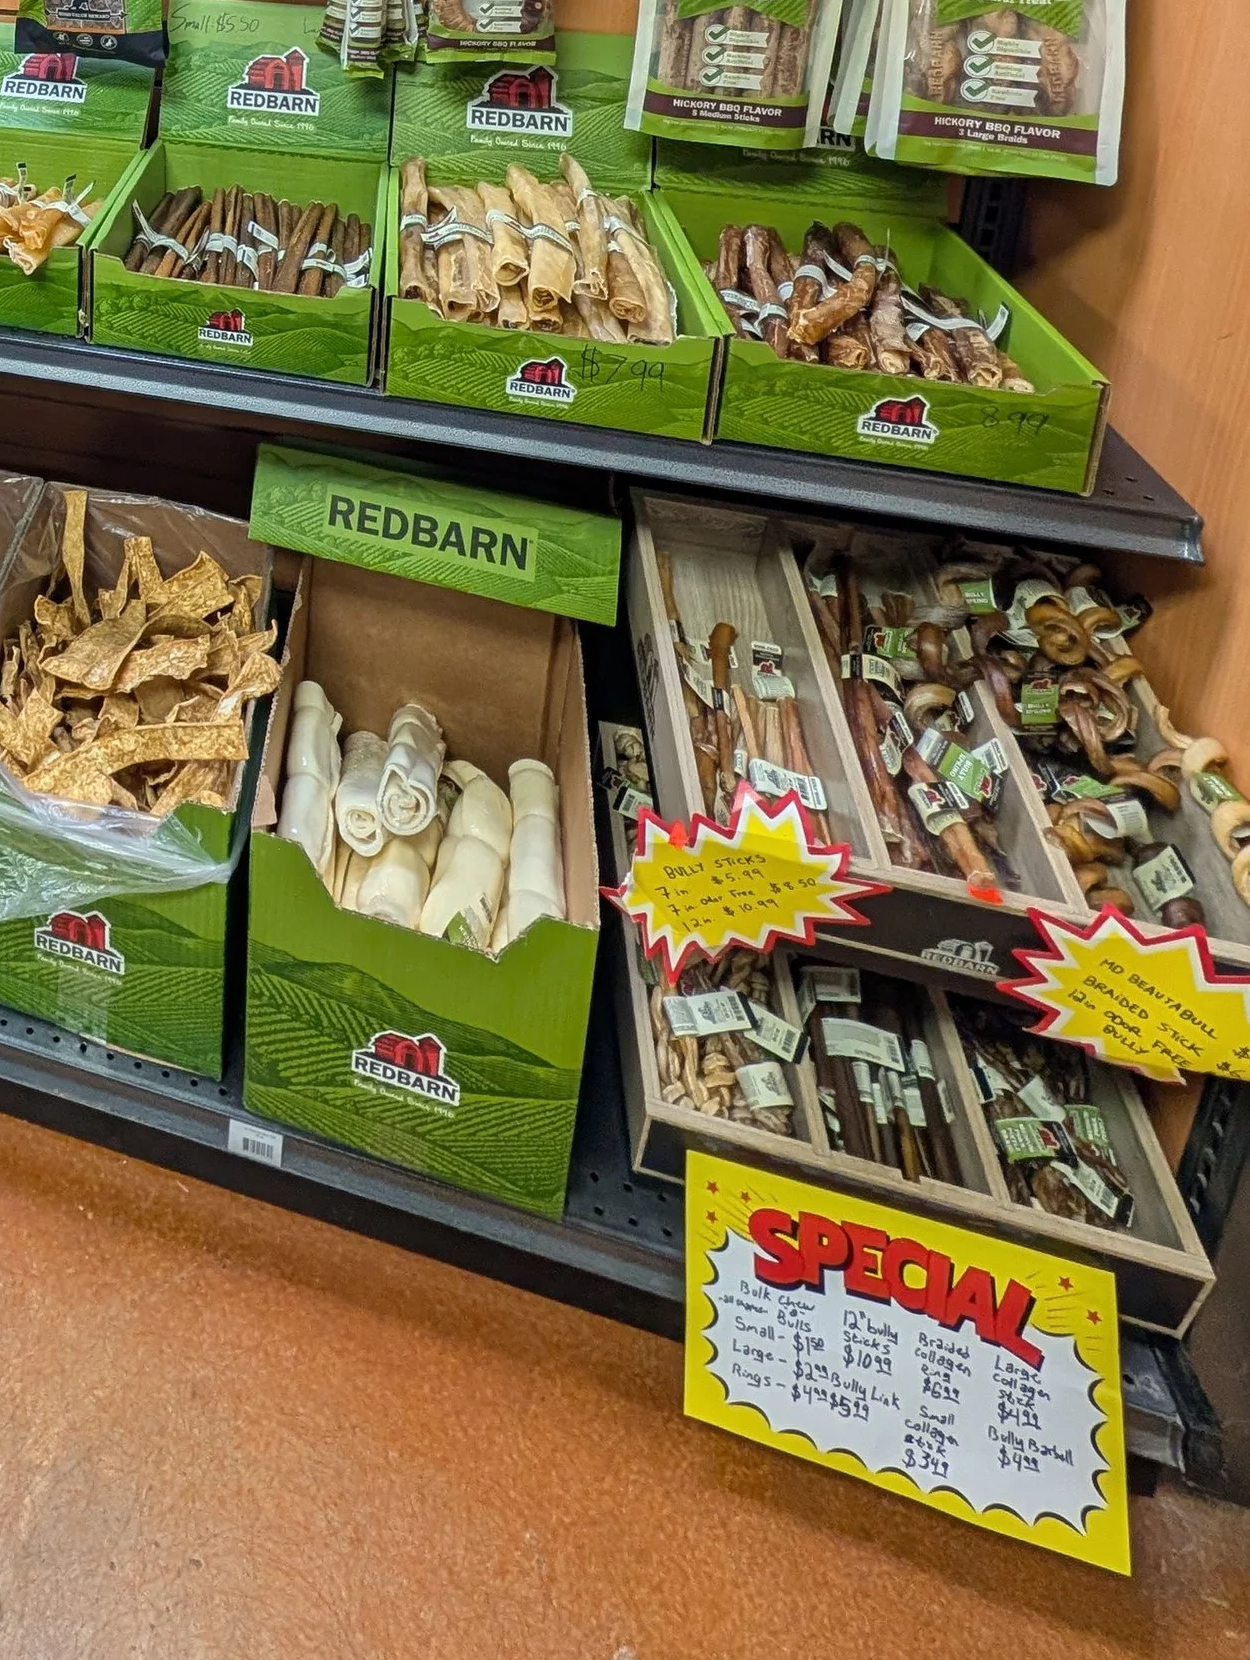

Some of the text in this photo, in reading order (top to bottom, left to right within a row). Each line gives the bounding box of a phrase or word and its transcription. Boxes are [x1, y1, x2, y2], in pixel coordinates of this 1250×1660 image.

[5, 80, 84, 101] REDBARN
[230, 91, 318, 113] REDBARN
[673, 99, 782, 116] HICKORY BBQ FLAVOR
[699, 110, 732, 120] Medium
[734, 113, 760, 122] Sticks
[228, 114, 314, 131] Family Owned Since 1996
[471, 109, 568, 132] REDBARN
[934, 117, 1061, 138] HICKORY BBQ FLAVOR
[470, 134, 567, 151] Family Owned Since 1996
[967, 130, 995, 140] Large
[997, 134, 1028, 143] Braids
[509, 381, 572, 401] REDBARN
[859, 420, 933, 442] REDBARN
[329, 494, 528, 570] REDBARN
[663, 854, 766, 879] BULLY STICKS
[655, 887, 669, 898] 7
[674, 887, 689, 896] in
[668, 904, 680, 916] 7
[683, 916, 700, 932] 12
[37, 933, 123, 974] REDBARN
[920, 948, 999, 974] REDBARN
[1100, 959, 1124, 975] MD
[1082, 976, 1203, 1057] BRAIDED STICK
[1103, 1026, 1150, 1056] BULLY
[1104, 1010, 1192, 1068] ODOR FREE
[354, 1056, 457, 1102] REDBARN
[748, 1207, 1044, 1371] SPECIAL
[777, 1309, 812, 1332] Bulls
[867, 1318, 898, 1345] bully
[919, 1332, 970, 1359] Braided
[995, 1355, 1042, 1384] Large
[831, 1372, 900, 1410] Bully Link
[919, 1405, 954, 1425] Small
[988, 1425, 1024, 1452] Bully
